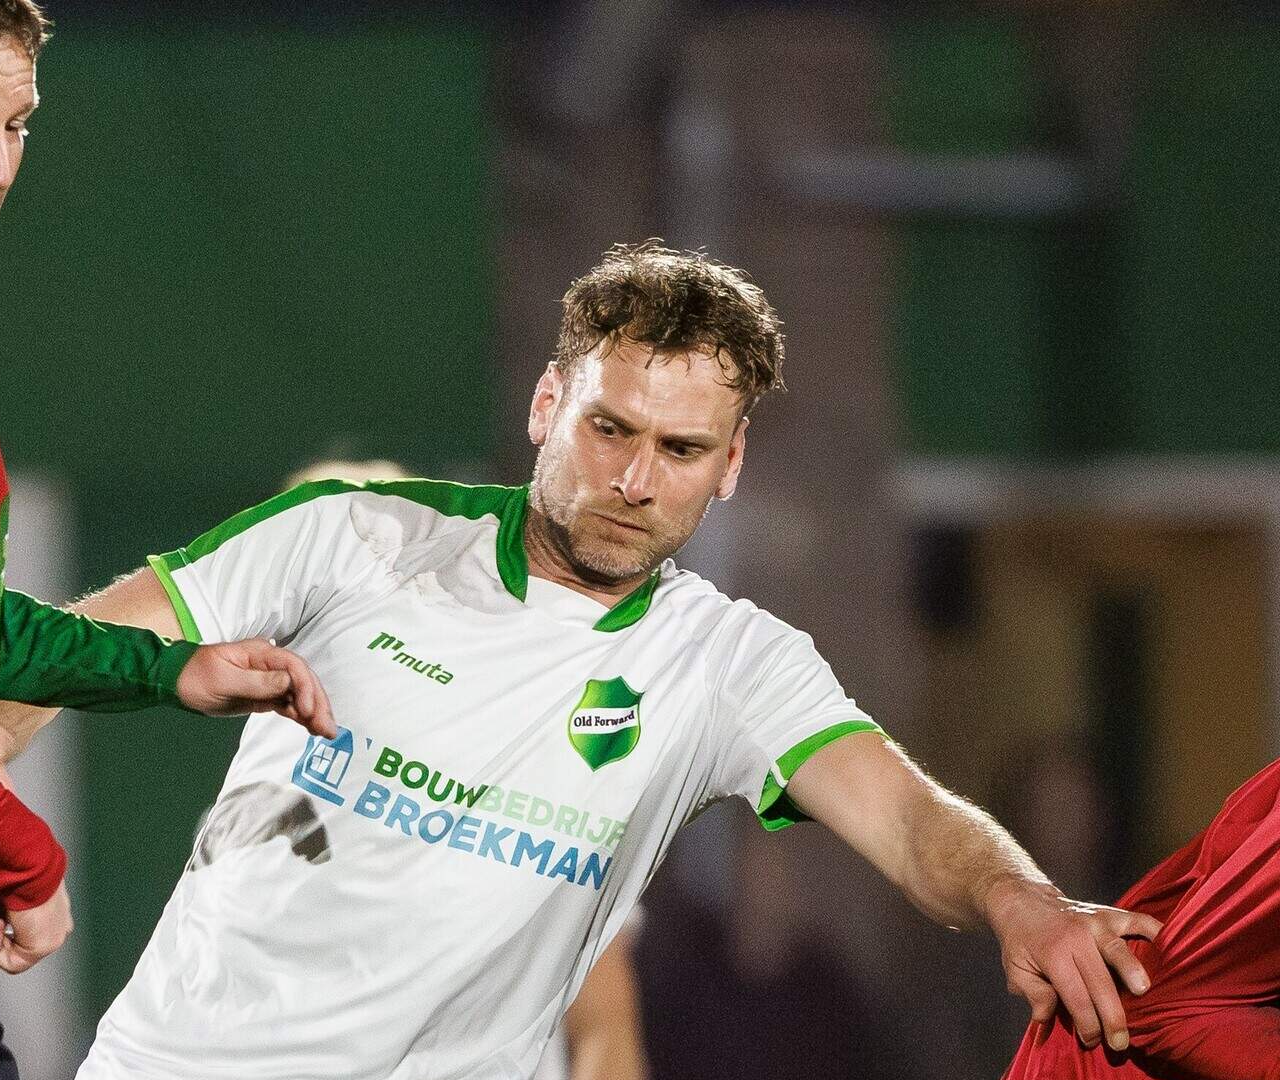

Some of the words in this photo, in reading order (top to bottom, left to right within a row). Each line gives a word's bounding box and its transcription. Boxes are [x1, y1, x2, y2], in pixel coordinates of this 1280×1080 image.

[391, 650, 454, 685] muta
[573, 715, 593, 728] Old
[594, 709, 636, 727] Forward
[353, 779, 614, 891] BROEKMAN
